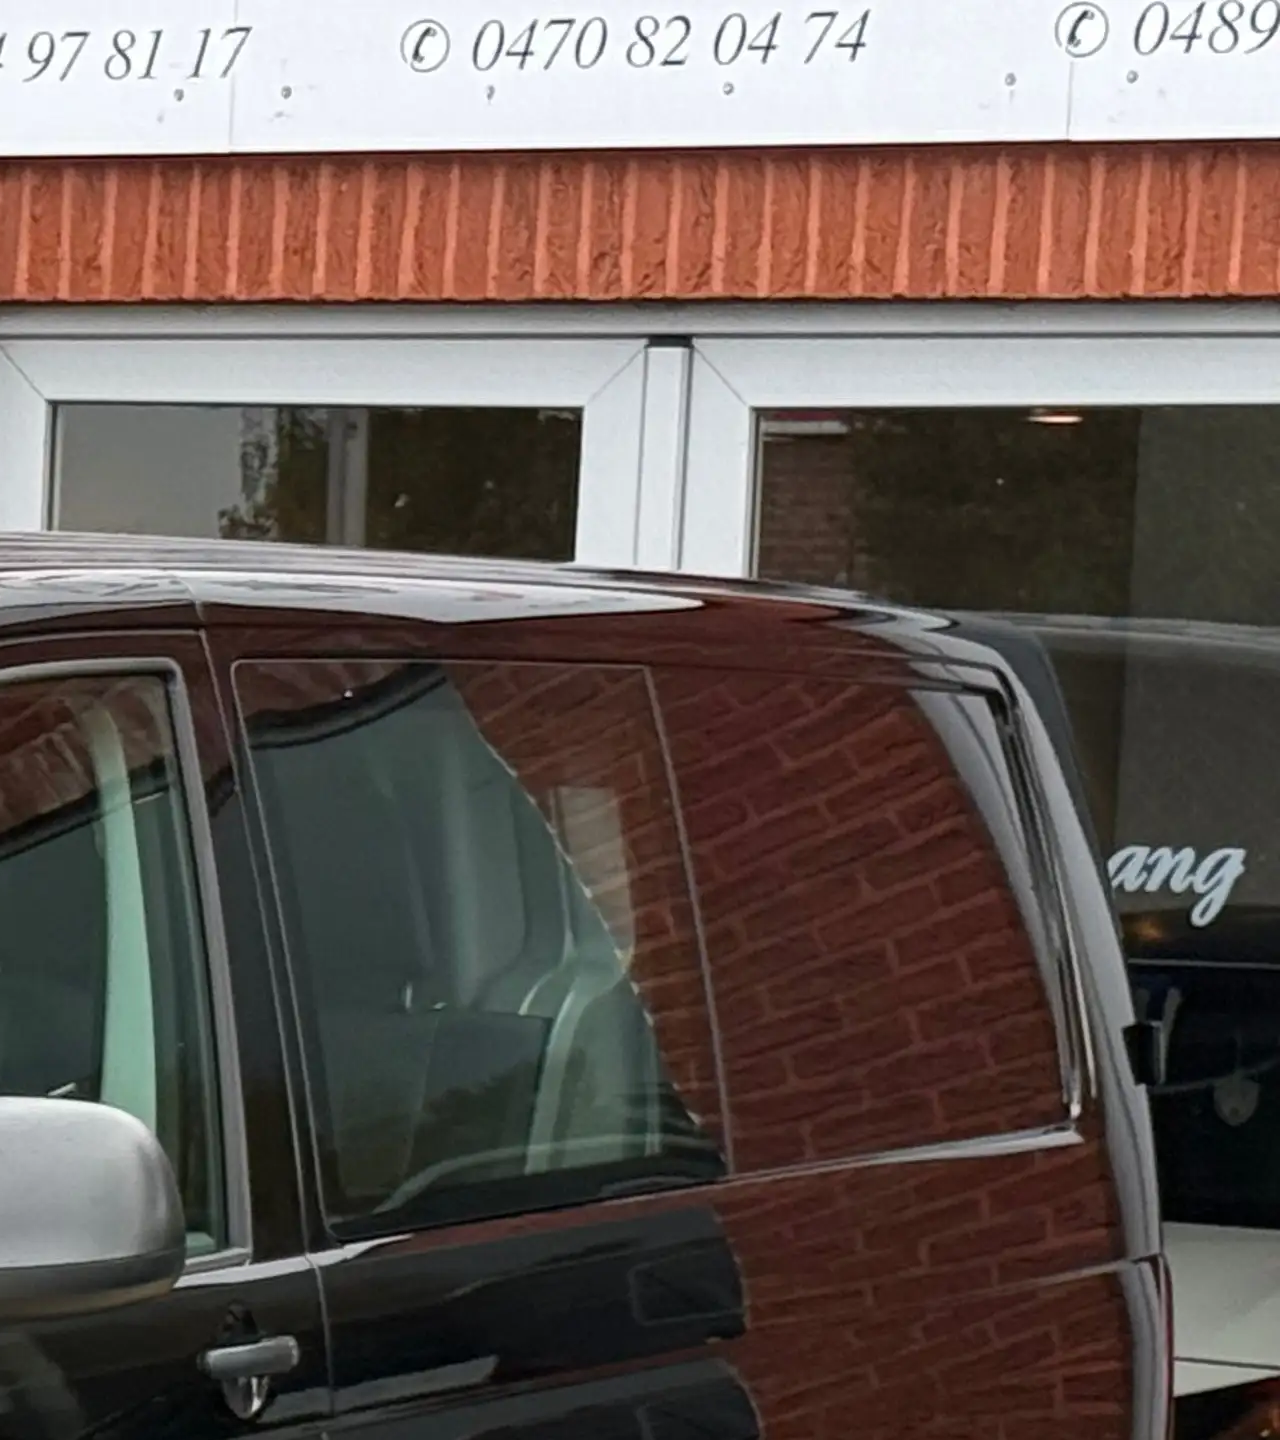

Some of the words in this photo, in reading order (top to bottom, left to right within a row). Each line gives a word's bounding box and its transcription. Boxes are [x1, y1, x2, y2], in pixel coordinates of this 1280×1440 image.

[23, 30, 88, 83] 97
[104, 28, 165, 81] 81
[186, 26, 253, 79] 17
[471, 17, 608, 71] 0470
[624, 14, 692, 68] 82
[712, 12, 780, 66] 04
[803, 10, 870, 63] 74
[1134, 0, 1280, 55] 0489
